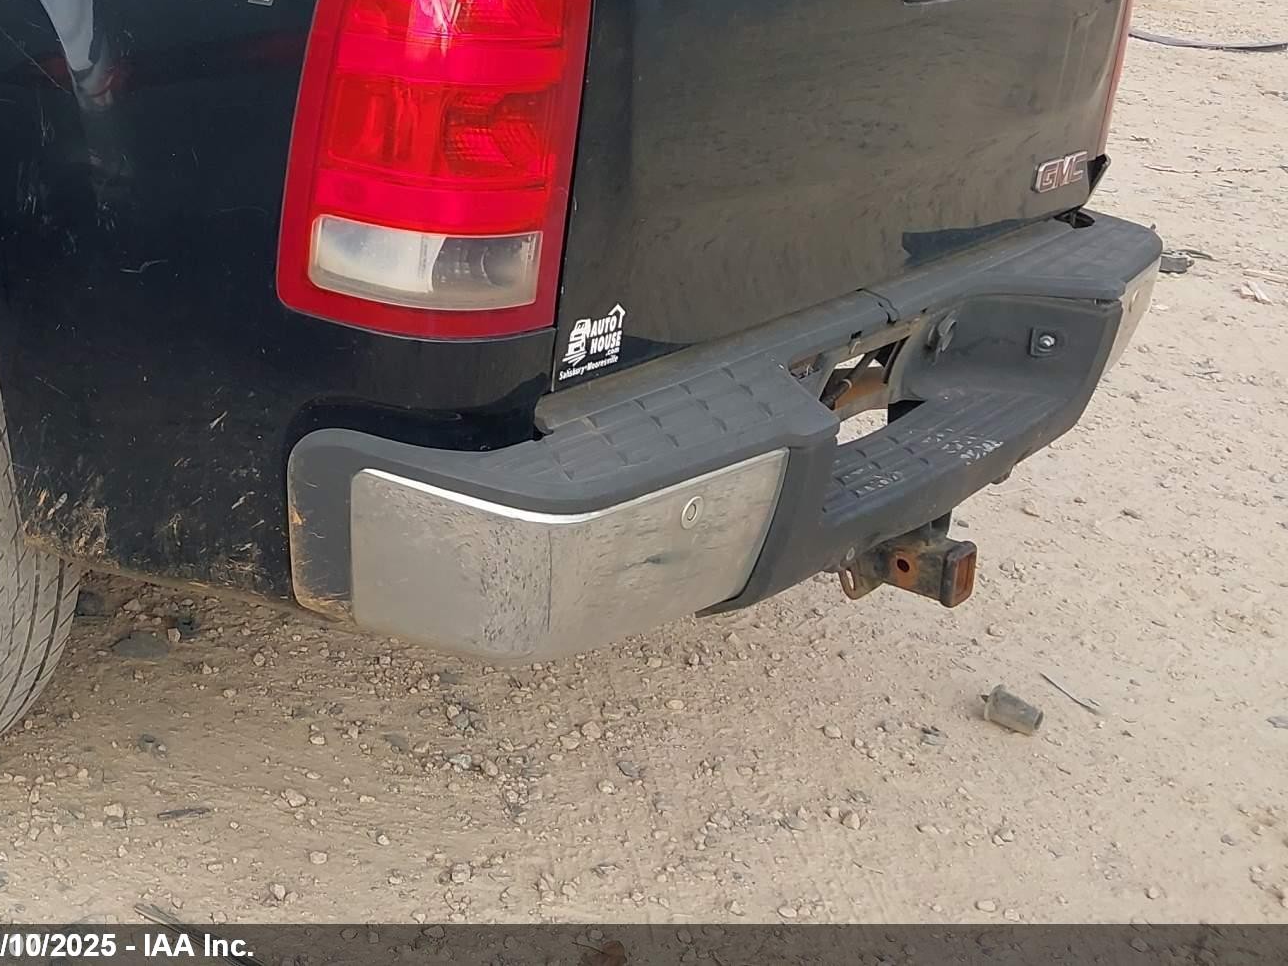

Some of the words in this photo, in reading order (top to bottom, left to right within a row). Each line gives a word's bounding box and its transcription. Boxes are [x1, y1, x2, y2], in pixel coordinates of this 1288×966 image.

[1035, 151, 1088, 193] GMC
[590, 316, 618, 338] AUTO
[590, 331, 622, 354] HOUSE
